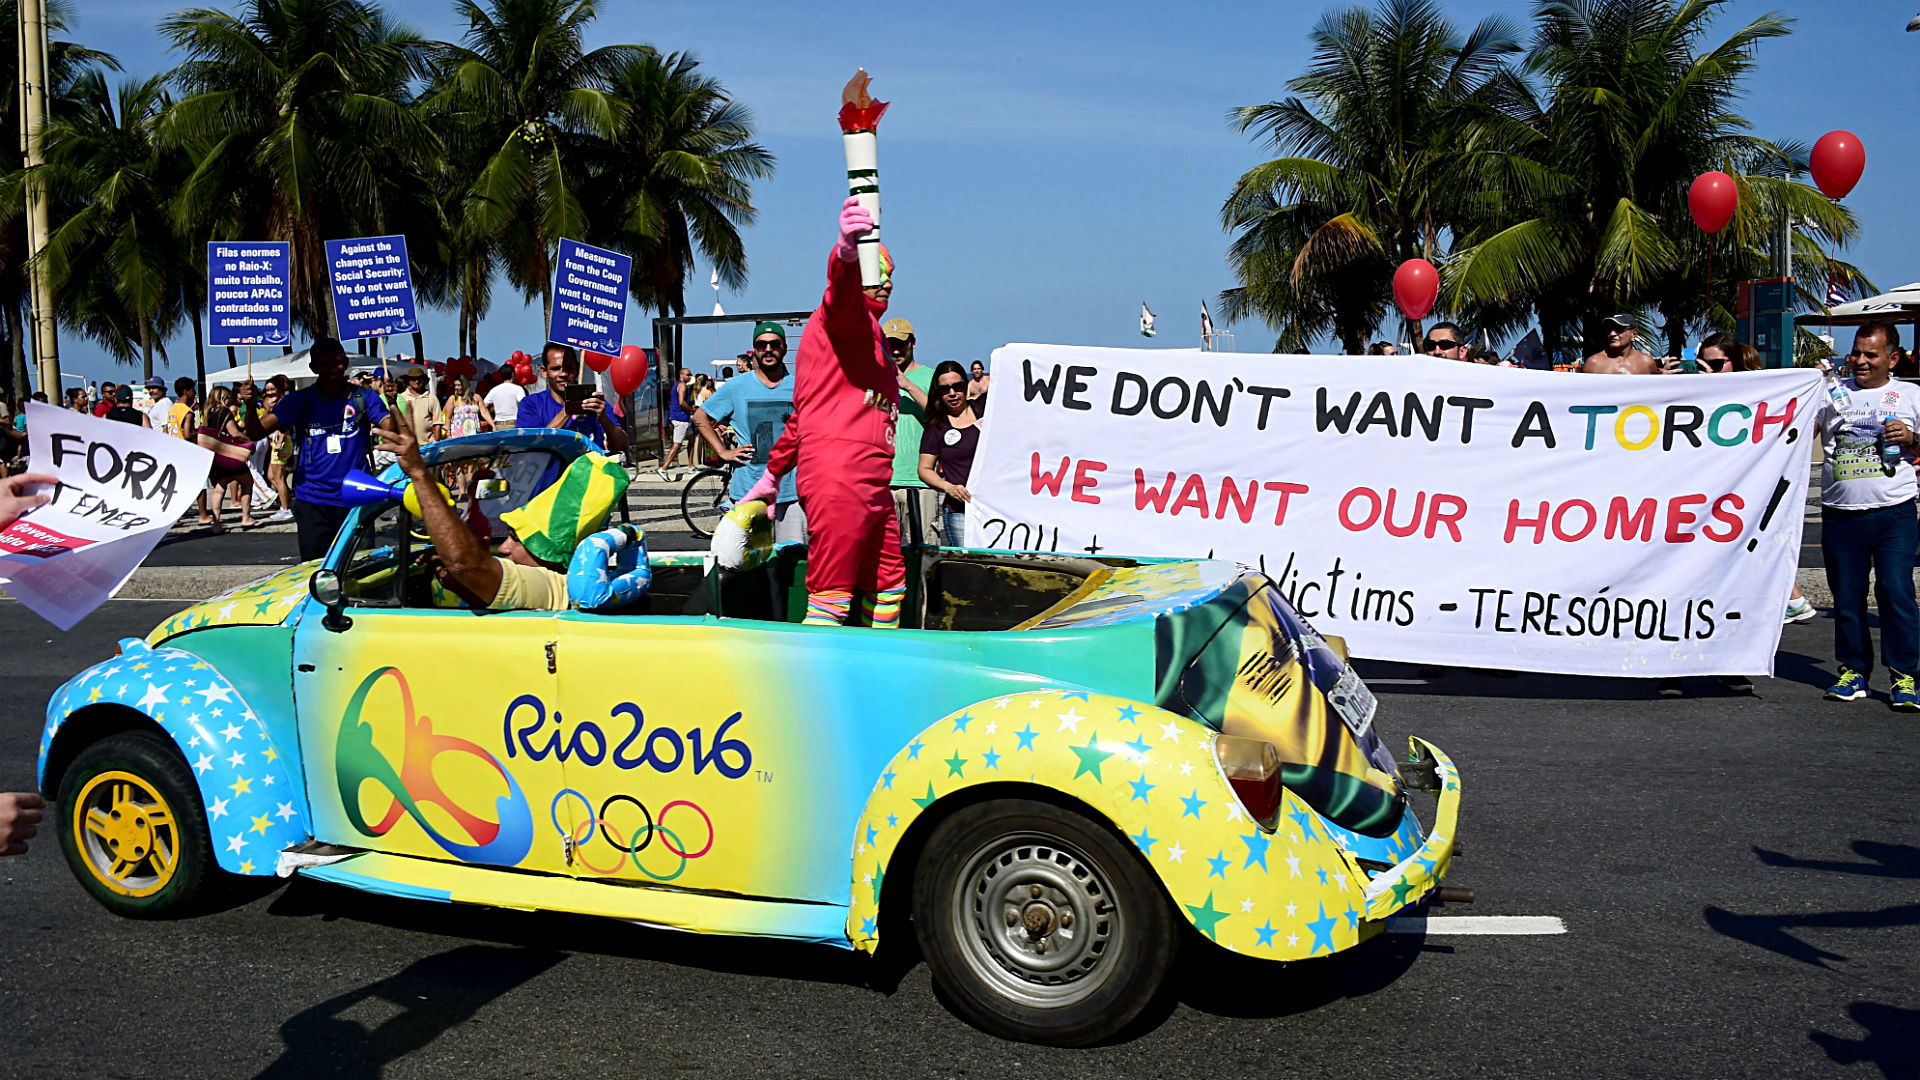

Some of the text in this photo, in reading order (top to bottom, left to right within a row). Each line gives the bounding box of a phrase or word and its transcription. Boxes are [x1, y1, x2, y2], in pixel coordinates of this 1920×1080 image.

[216, 247, 281, 258] Filas enormes
[340, 242, 392, 256] Against the
[335, 254, 401, 270] changes in the
[575, 247, 616, 267] Measures
[225, 261, 273, 271] no Raio-X:
[565, 258, 623, 284] from the Coup
[214, 275, 283, 287] muito trabalho,
[335, 267, 405, 282] Social Security:
[336, 280, 408, 295] We do not want
[568, 273, 618, 295] Government
[215, 288, 283, 301] poucos APACs
[350, 293, 399, 307] to die from
[558, 287, 623, 310] want to remove
[214, 302, 284, 313] contratados no
[348, 307, 405, 321] overworking
[560, 301, 618, 323] working class
[221, 316, 278, 327] atendimento
[567, 317, 608, 334] privileges
[1022, 359, 1799, 452] WE DON'T WANT A TORCH,
[50, 433, 178, 513] FORA
[1030, 451, 1791, 553] WE WANT OUR HOMES!
[983, 518, 1058, 552] 2011
